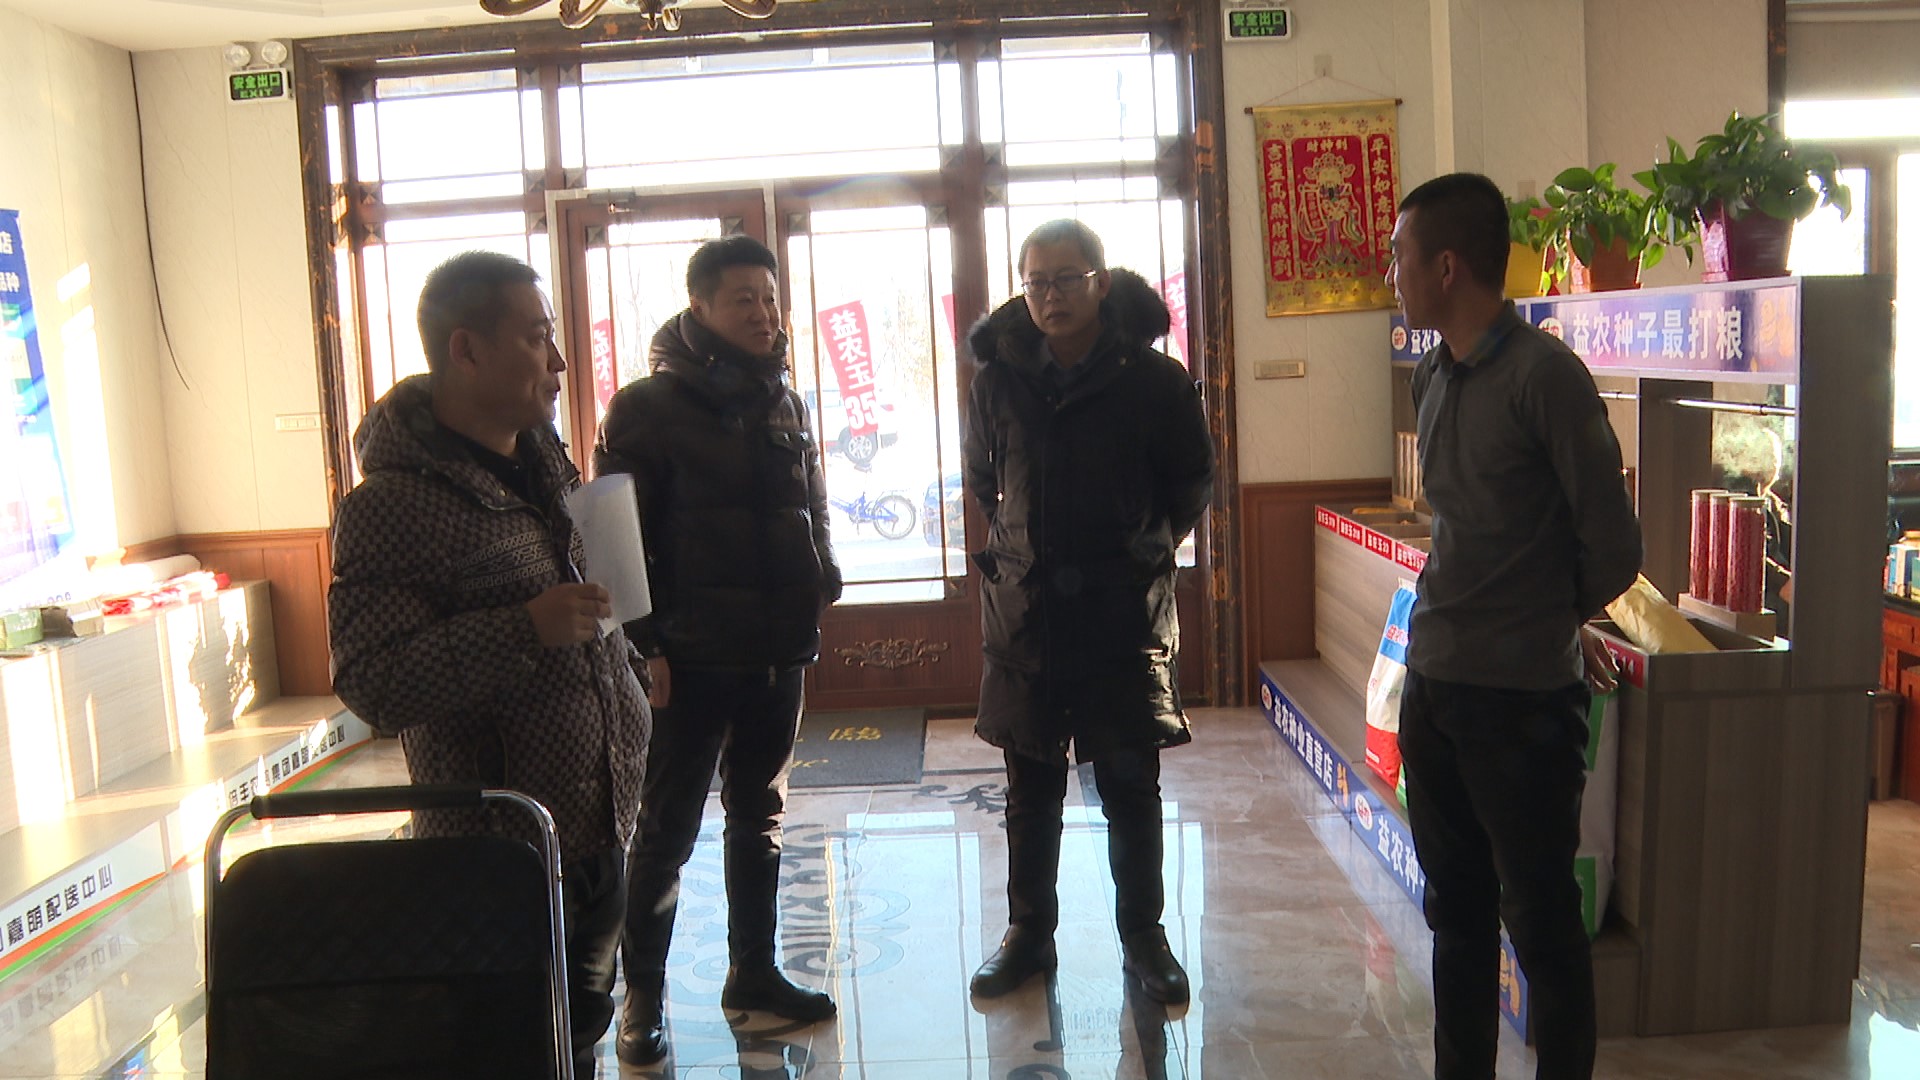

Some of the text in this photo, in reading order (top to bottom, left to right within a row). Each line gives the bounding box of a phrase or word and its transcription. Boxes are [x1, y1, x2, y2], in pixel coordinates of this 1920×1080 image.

[1232, 11, 1284, 26] 安全出口
[1240, 26, 1276, 36] EXIT
[232, 73, 280, 90] 安全出口
[239, 88, 272, 98] EXIT
[1572, 306, 1743, 361] 益农种子最打粮
[828, 309, 879, 430] 益农玉35
[1274, 695, 1333, 791] 益农种业直营店
[1378, 815, 1425, 894] 益农种
[0, 864, 113, 951] 嘉萌配送中心
